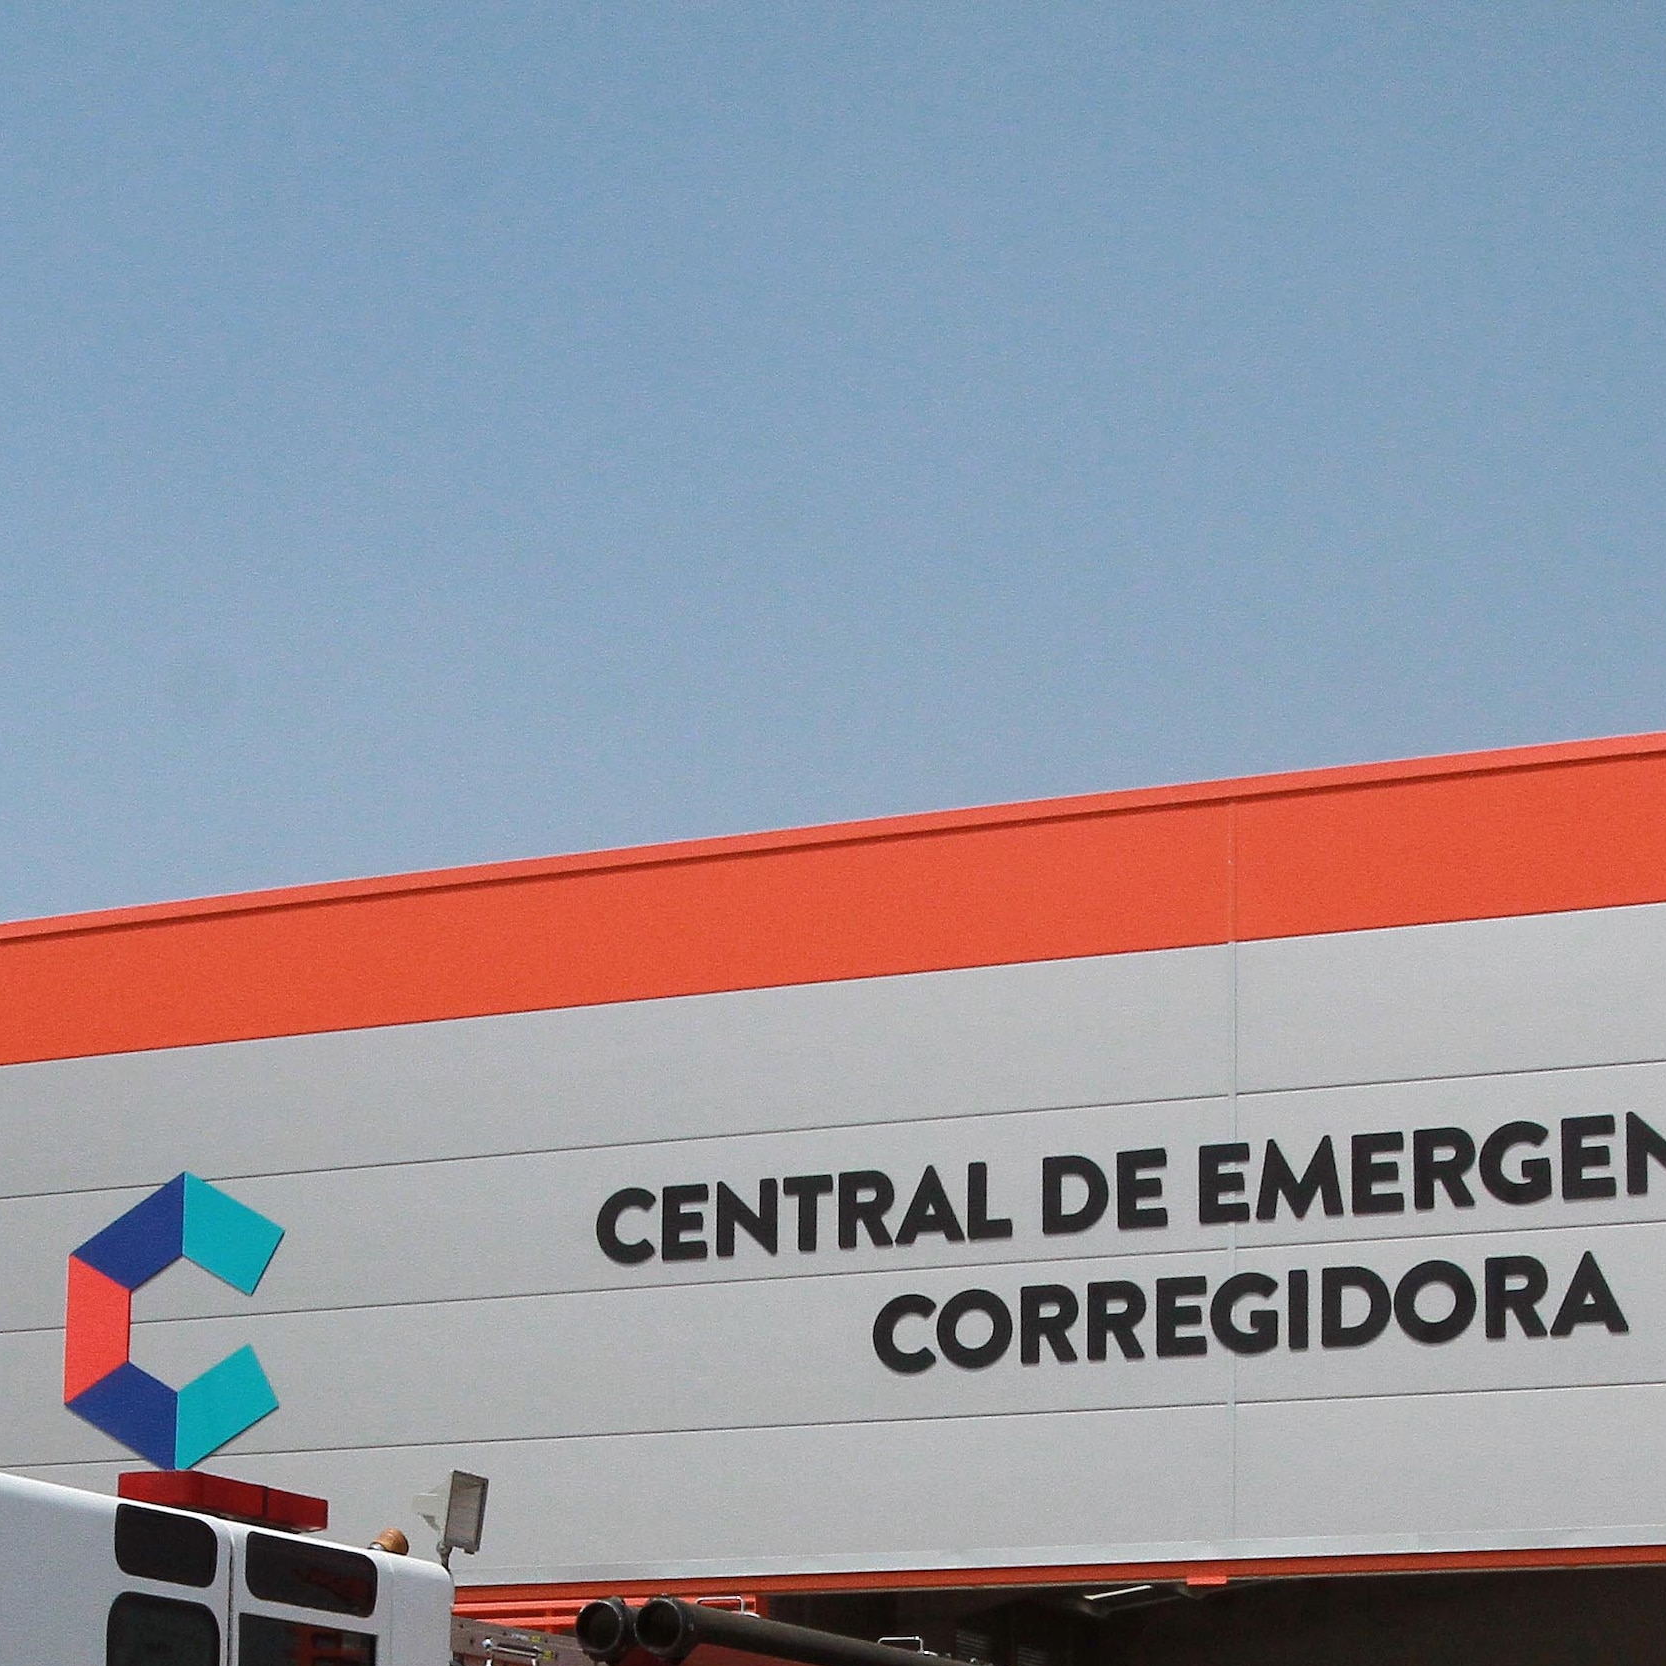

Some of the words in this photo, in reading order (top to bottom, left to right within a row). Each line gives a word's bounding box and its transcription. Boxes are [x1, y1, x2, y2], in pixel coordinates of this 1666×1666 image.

[596, 1159, 1014, 1265] CENTRAL
[1042, 1147, 1169, 1235] DE
[871, 1250, 1630, 1374] CORREGIDORA
